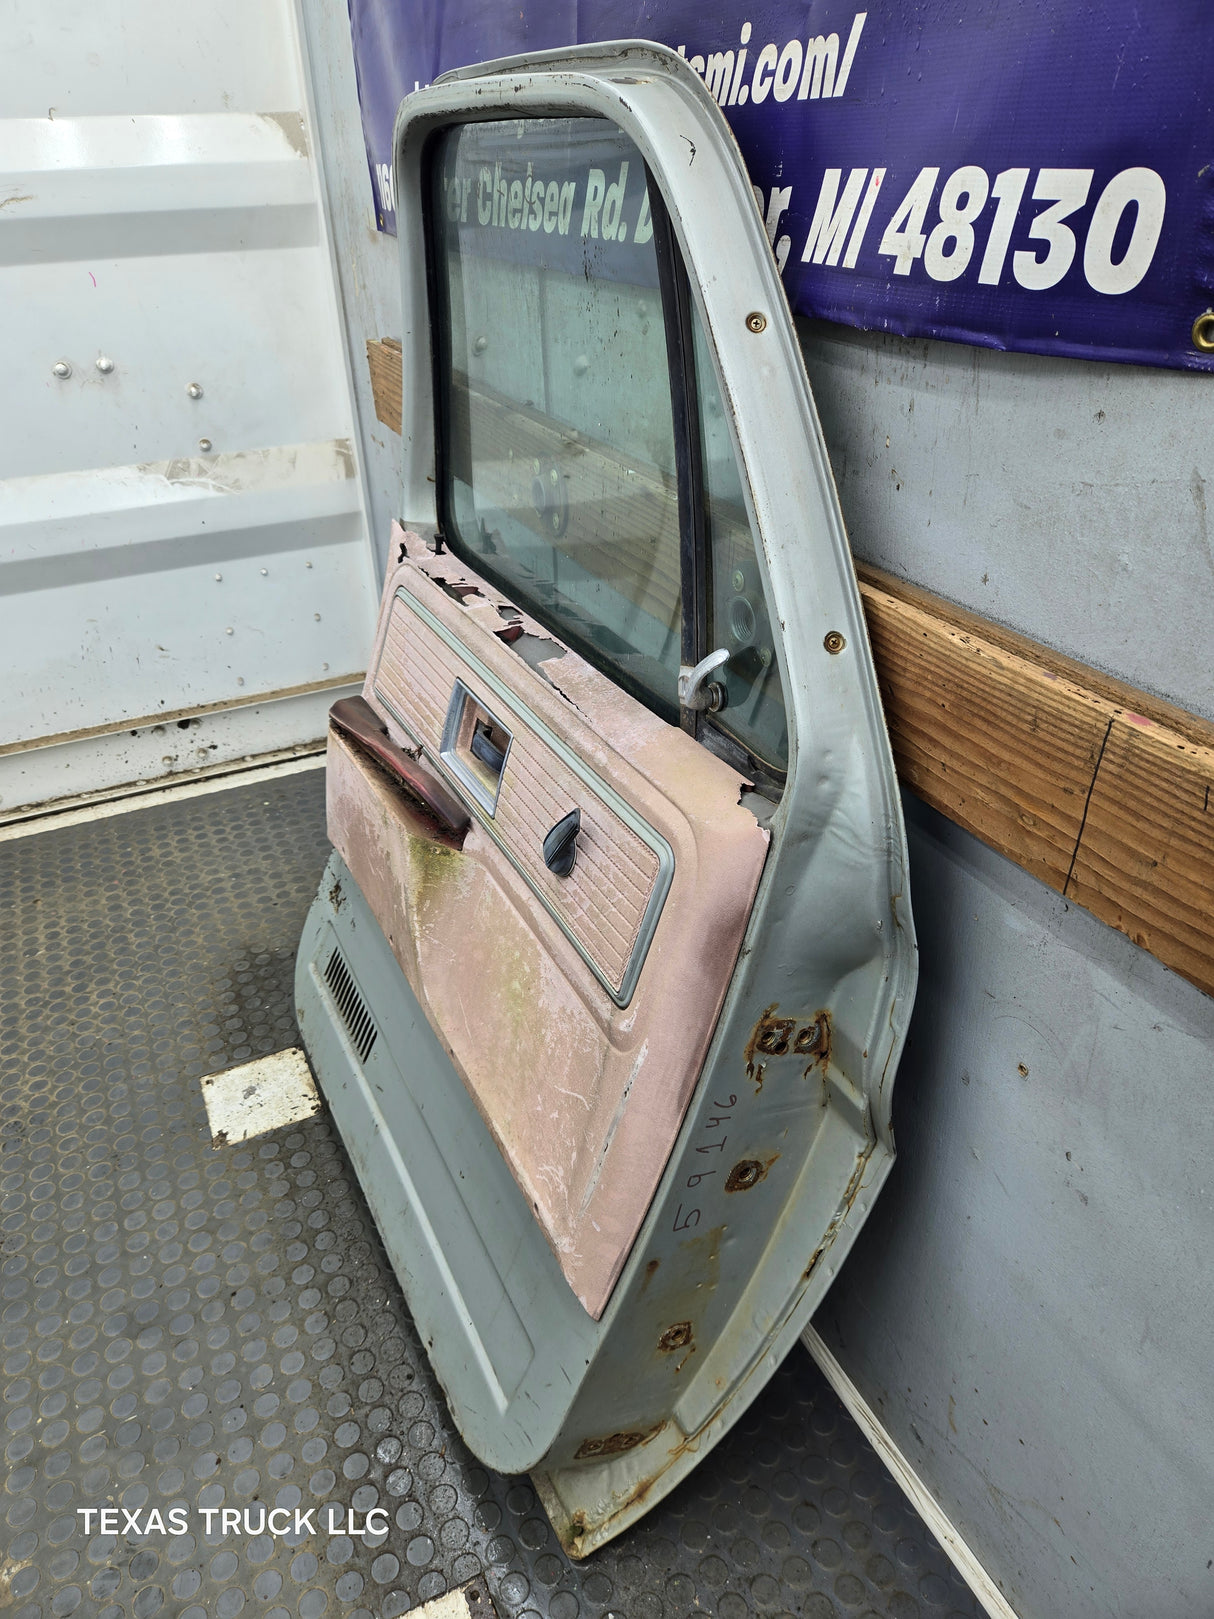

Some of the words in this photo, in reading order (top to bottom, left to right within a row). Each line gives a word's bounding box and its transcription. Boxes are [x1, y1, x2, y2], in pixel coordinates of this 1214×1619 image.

[477, 161, 577, 235] Chelsea
[580, 161, 630, 243] Rd.
[800, 167, 887, 269] MI
[878, 165, 1167, 295] 48130
[672, 1094, 737, 1232] 59146
